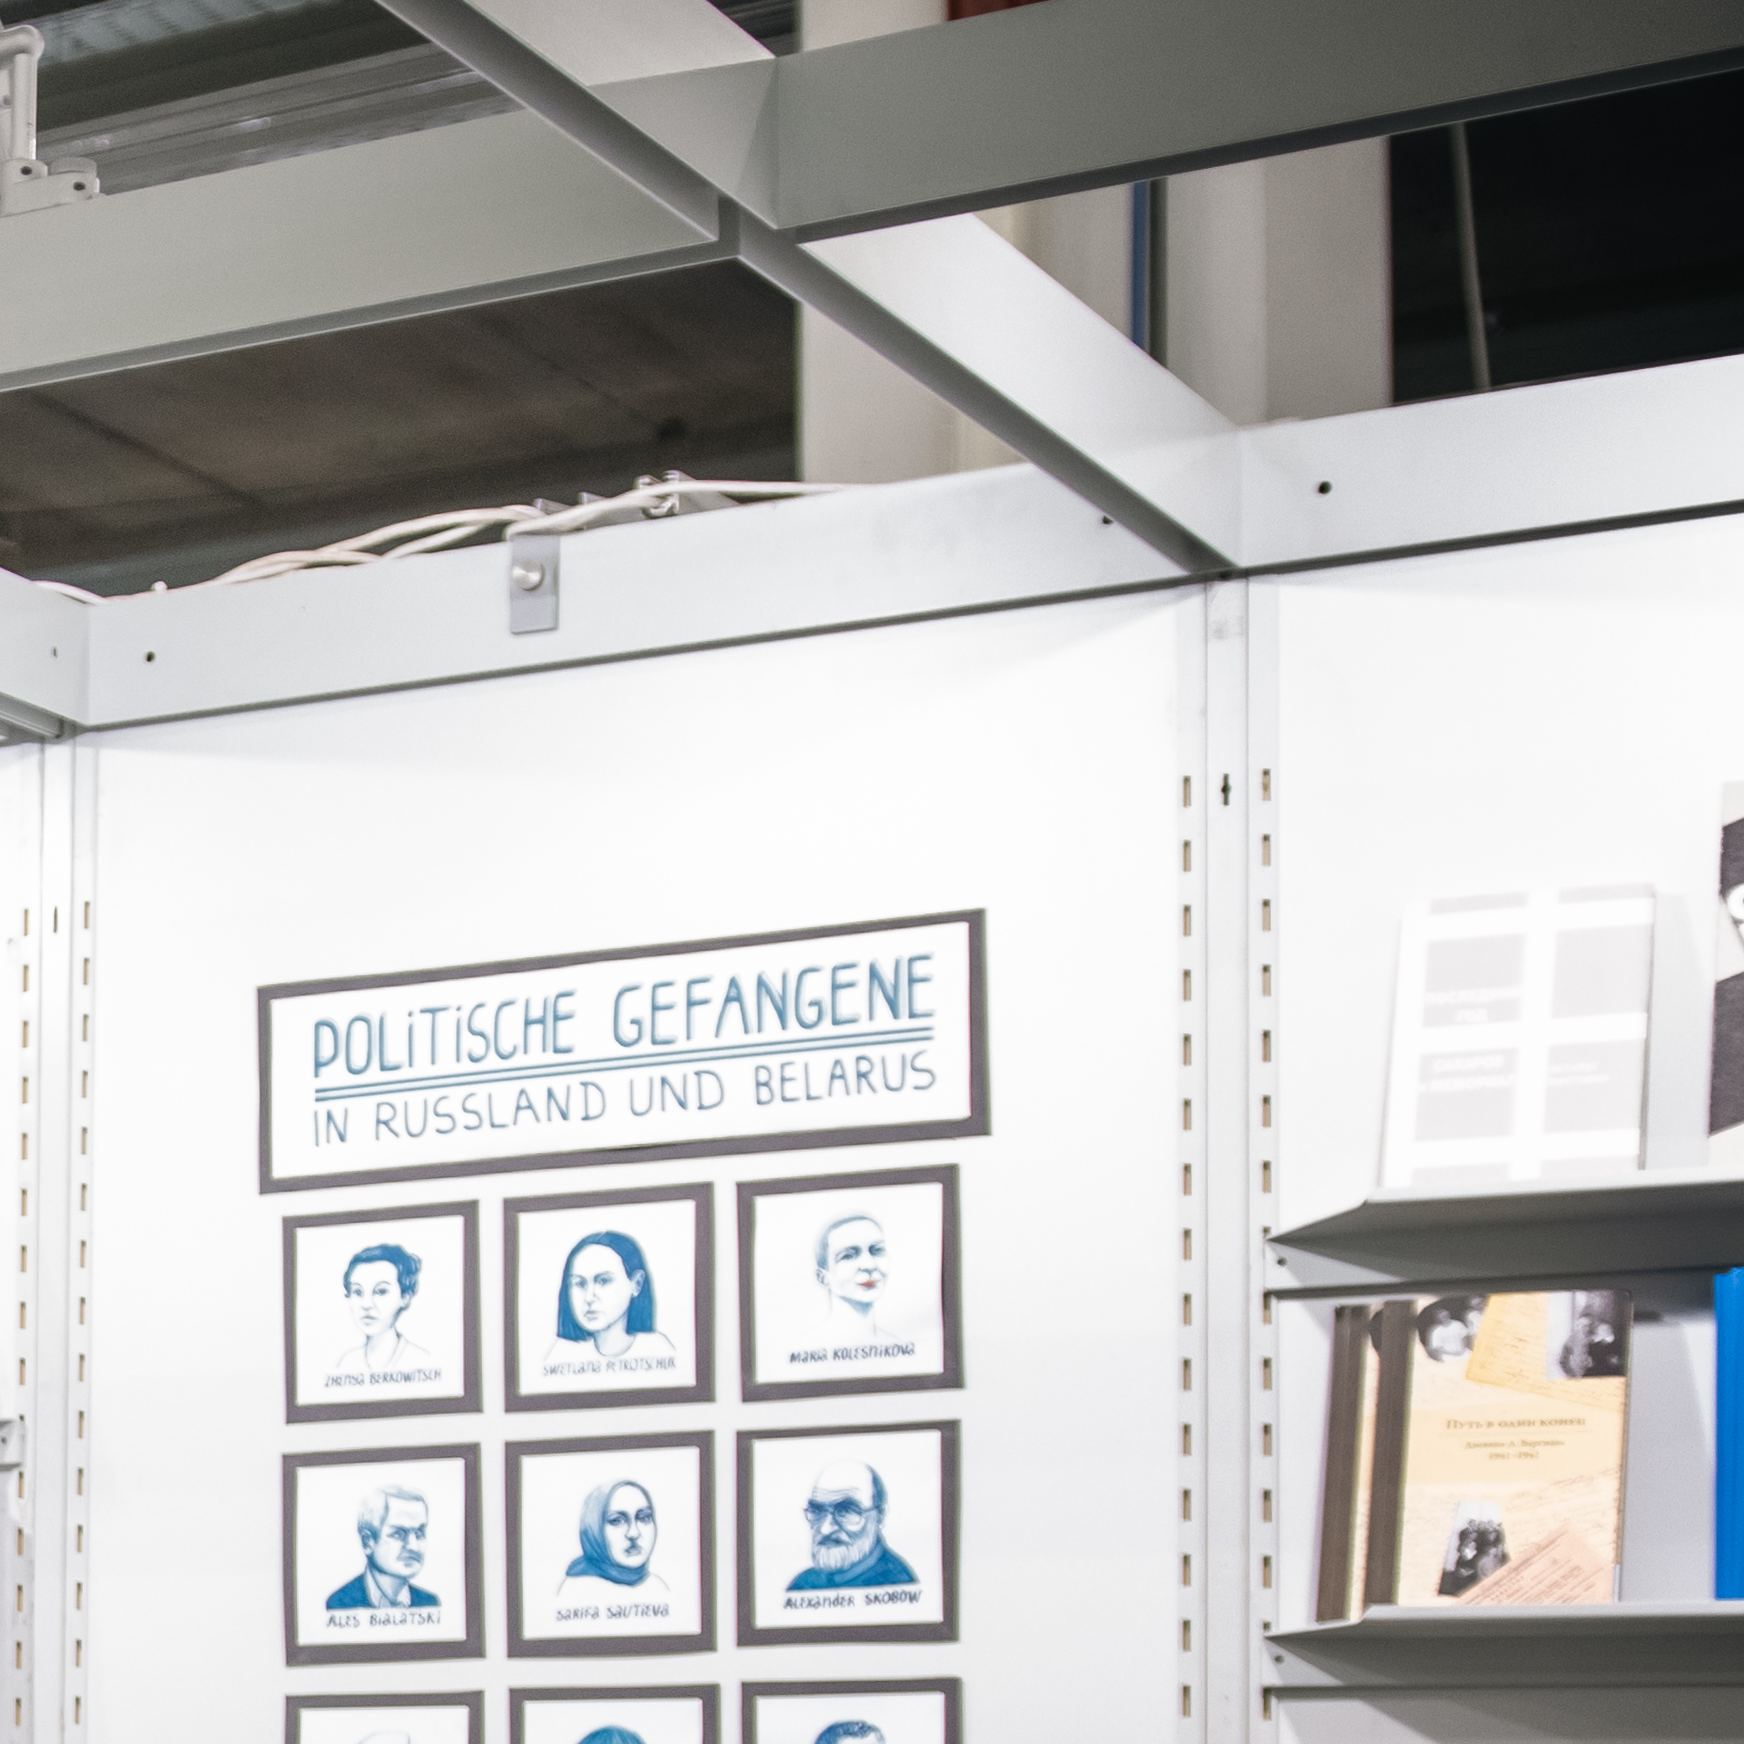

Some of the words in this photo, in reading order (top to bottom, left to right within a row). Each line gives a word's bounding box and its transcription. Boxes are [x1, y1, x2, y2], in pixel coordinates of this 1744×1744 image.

[612, 953, 937, 1050] GEFANGENE
[312, 1109, 349, 1148] IN
[374, 1081, 607, 1142] RUSSLAND
[629, 1070, 726, 1119] UND
[755, 1049, 938, 1107] BELARUS
